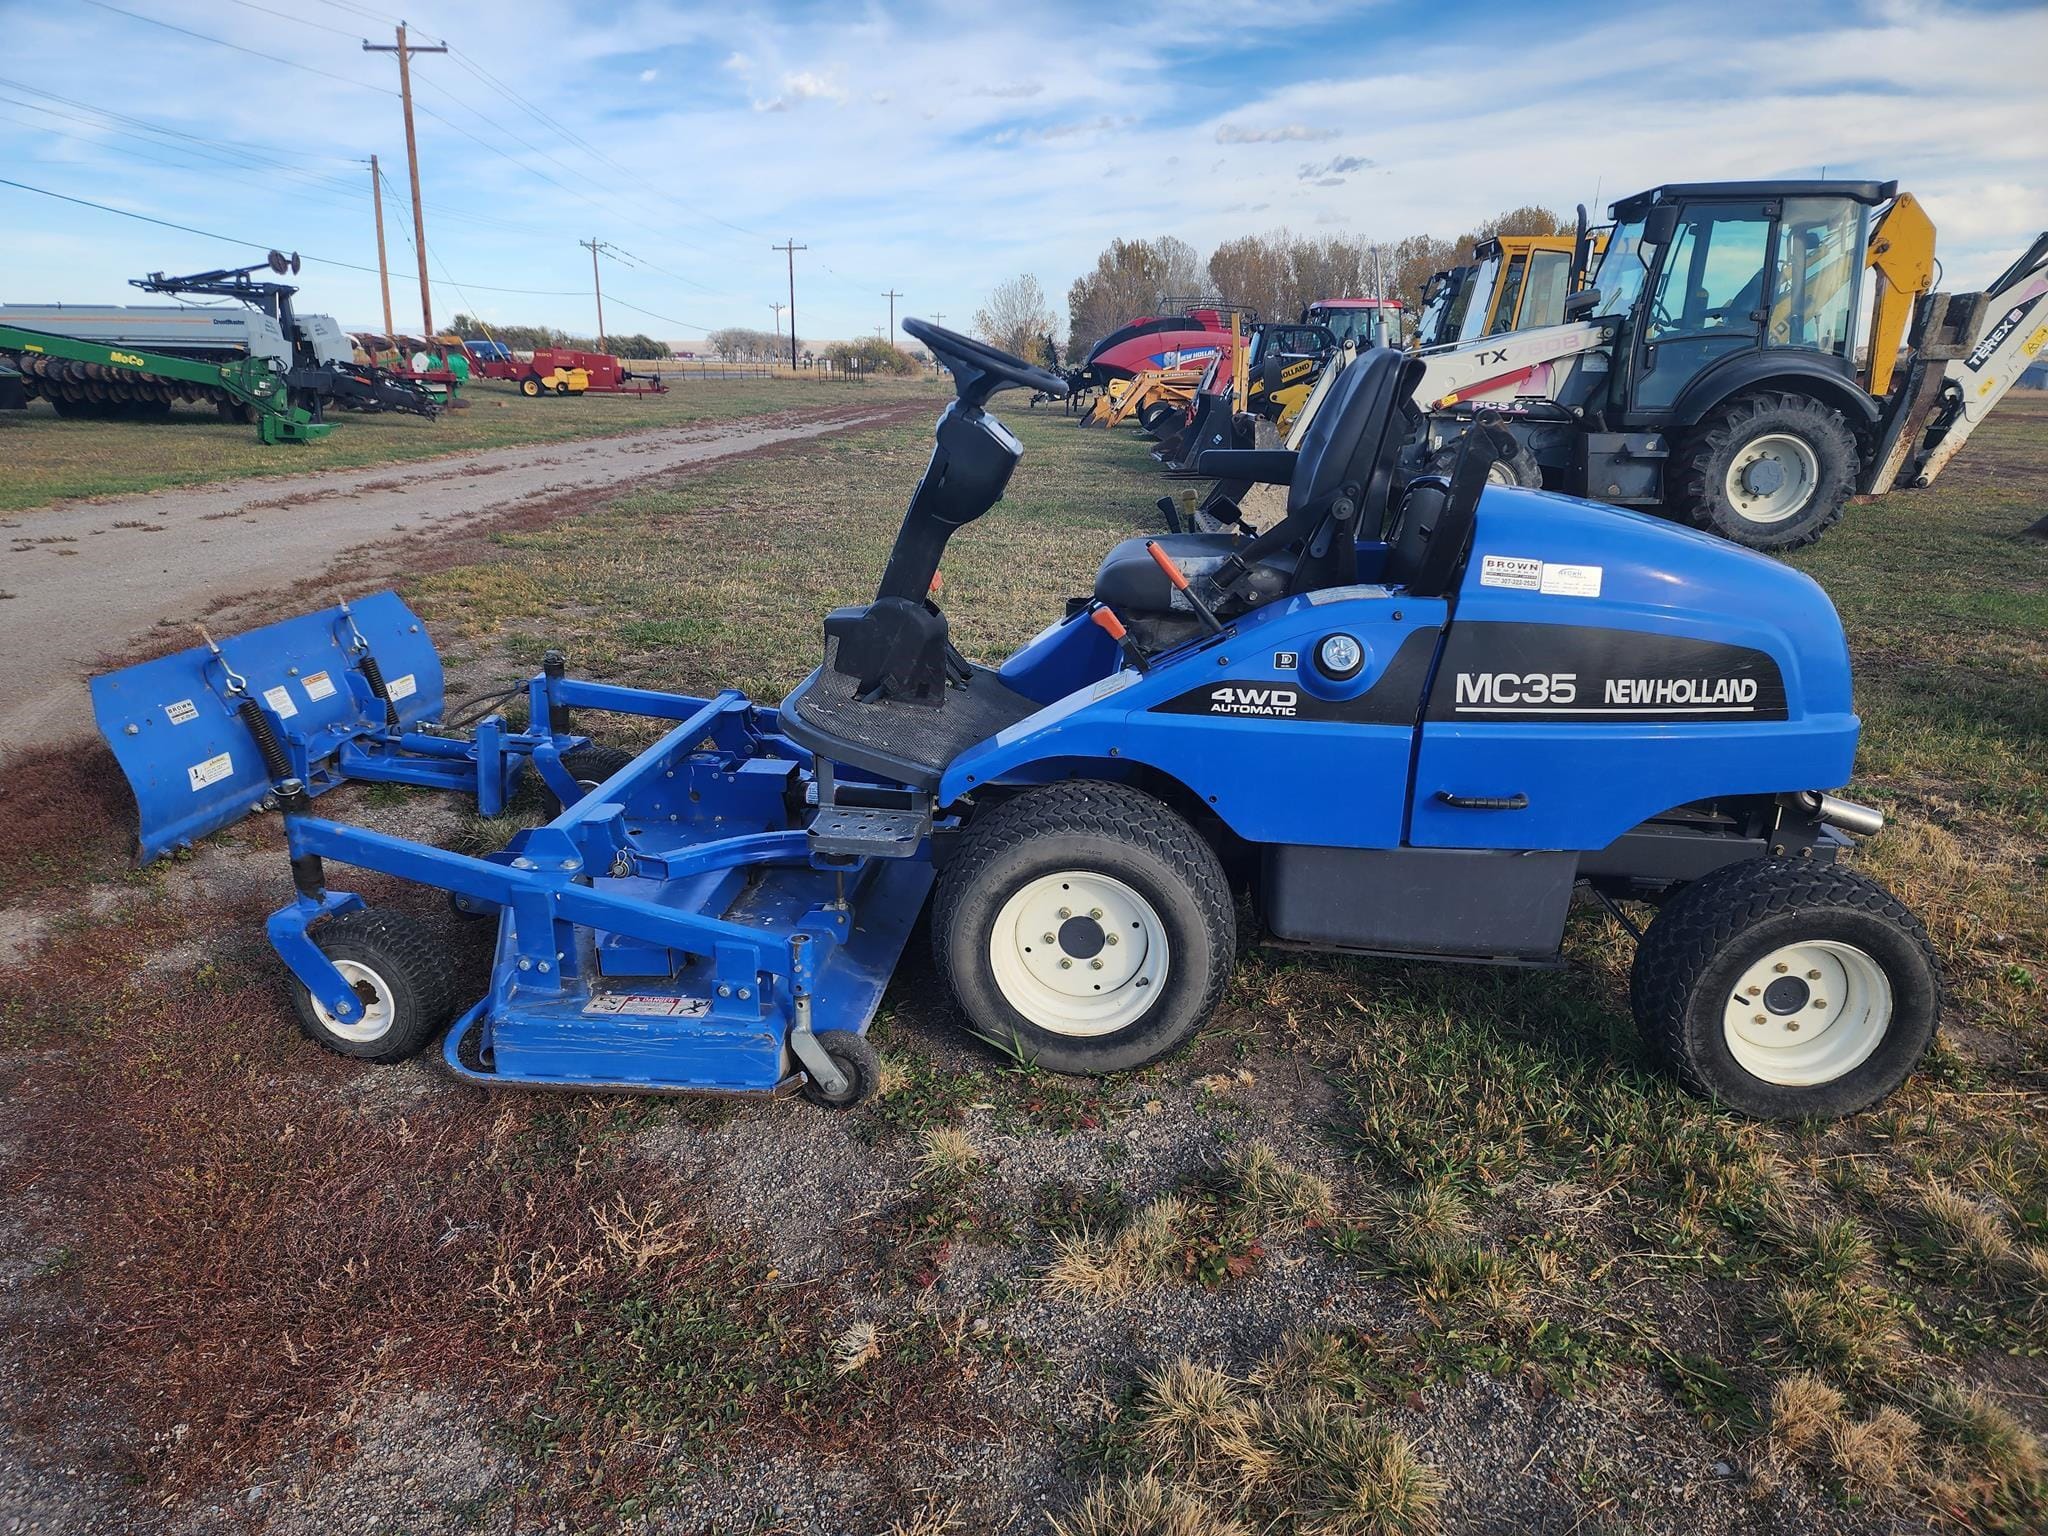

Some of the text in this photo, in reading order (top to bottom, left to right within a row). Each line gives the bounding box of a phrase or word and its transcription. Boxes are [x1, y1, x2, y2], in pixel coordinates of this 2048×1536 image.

[1968, 320, 2014, 365] TEREX
[111, 351, 144, 366] MoCo
[1475, 348, 1508, 366] TX
[1282, 363, 1310, 378] OLLAND
[1487, 560, 1539, 571] BROWN
[1455, 673, 1577, 704] MC35
[1211, 687, 1297, 707] 4WD
[168, 702, 193, 714] BROWN
[1210, 703, 1297, 716] AUTOMATIC
